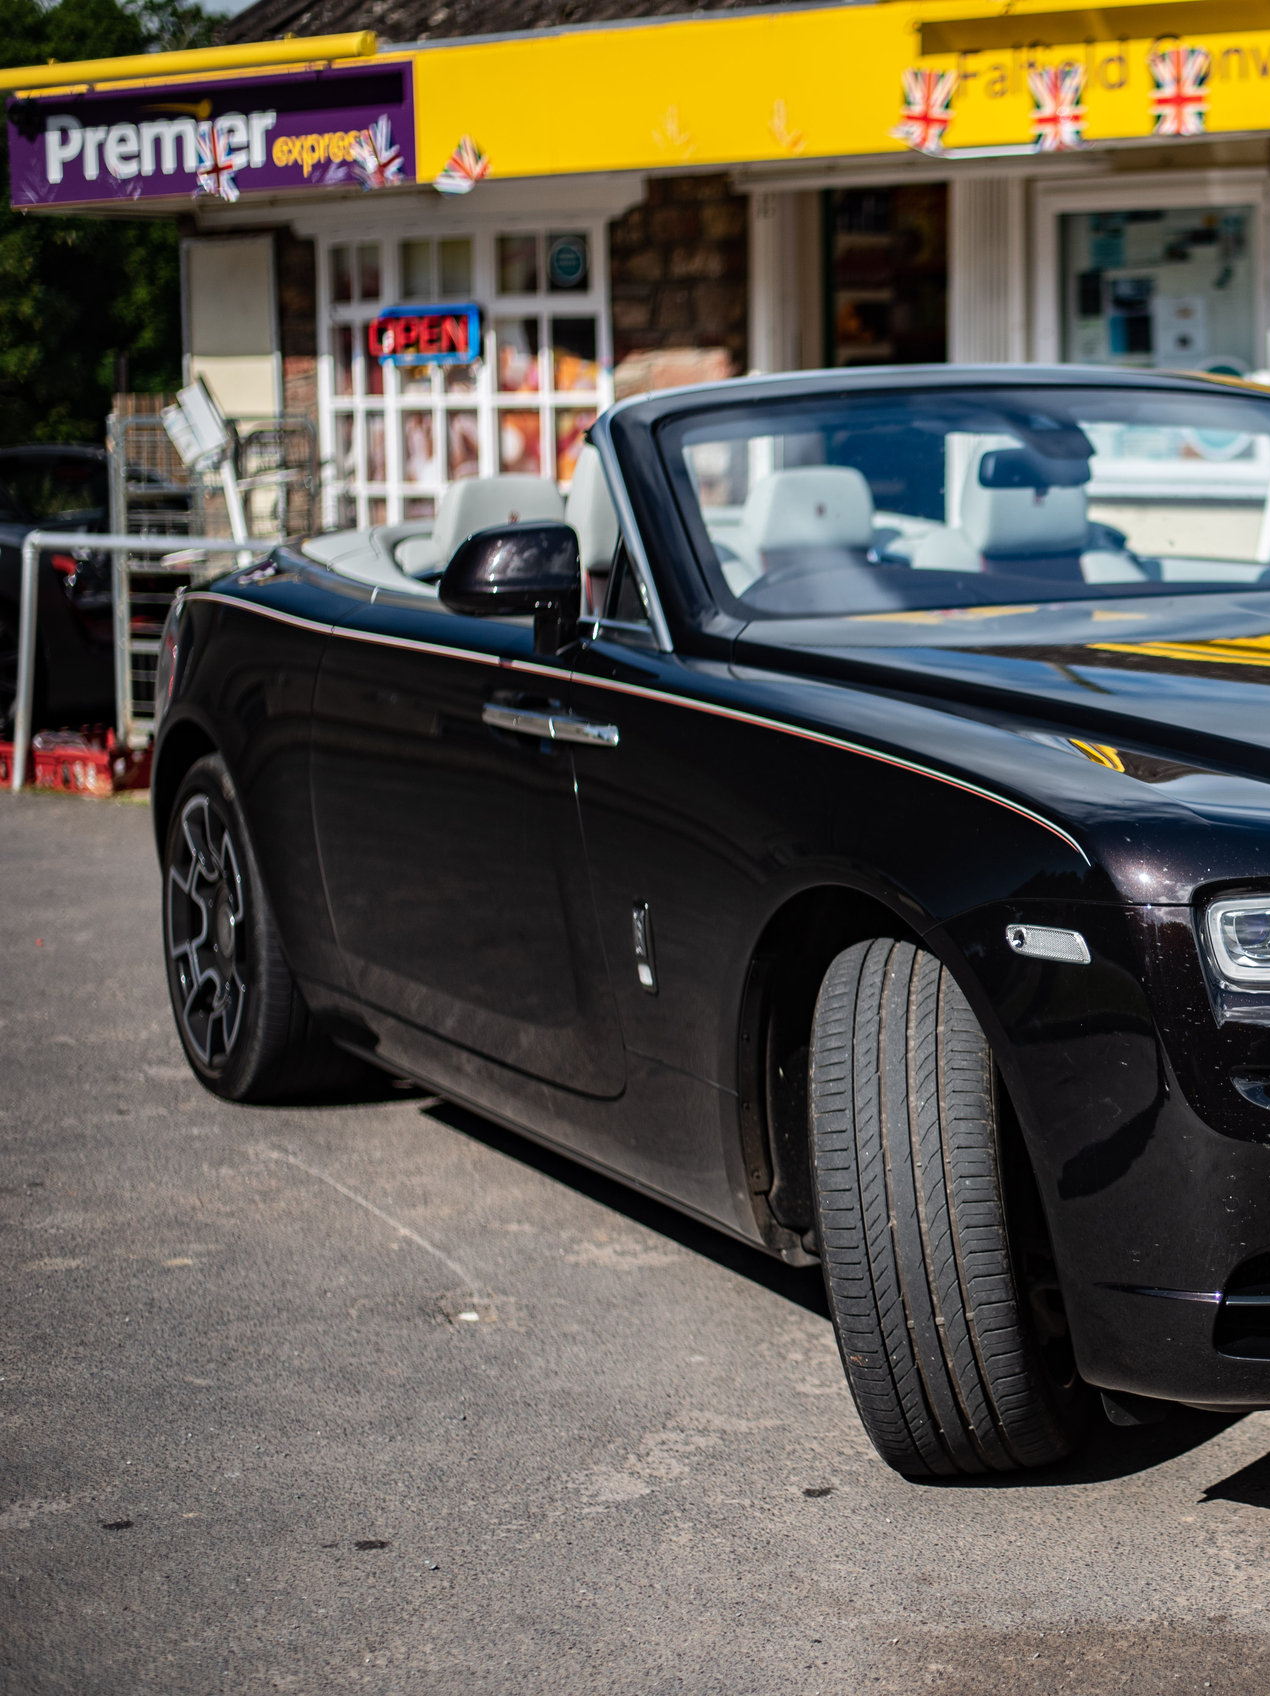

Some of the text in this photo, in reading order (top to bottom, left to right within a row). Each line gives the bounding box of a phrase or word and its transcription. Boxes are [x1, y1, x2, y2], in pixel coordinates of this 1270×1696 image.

[958, 37, 1129, 99] Falfld
[46, 108, 364, 185] Premer expres
[369, 314, 469, 357] OPEN
